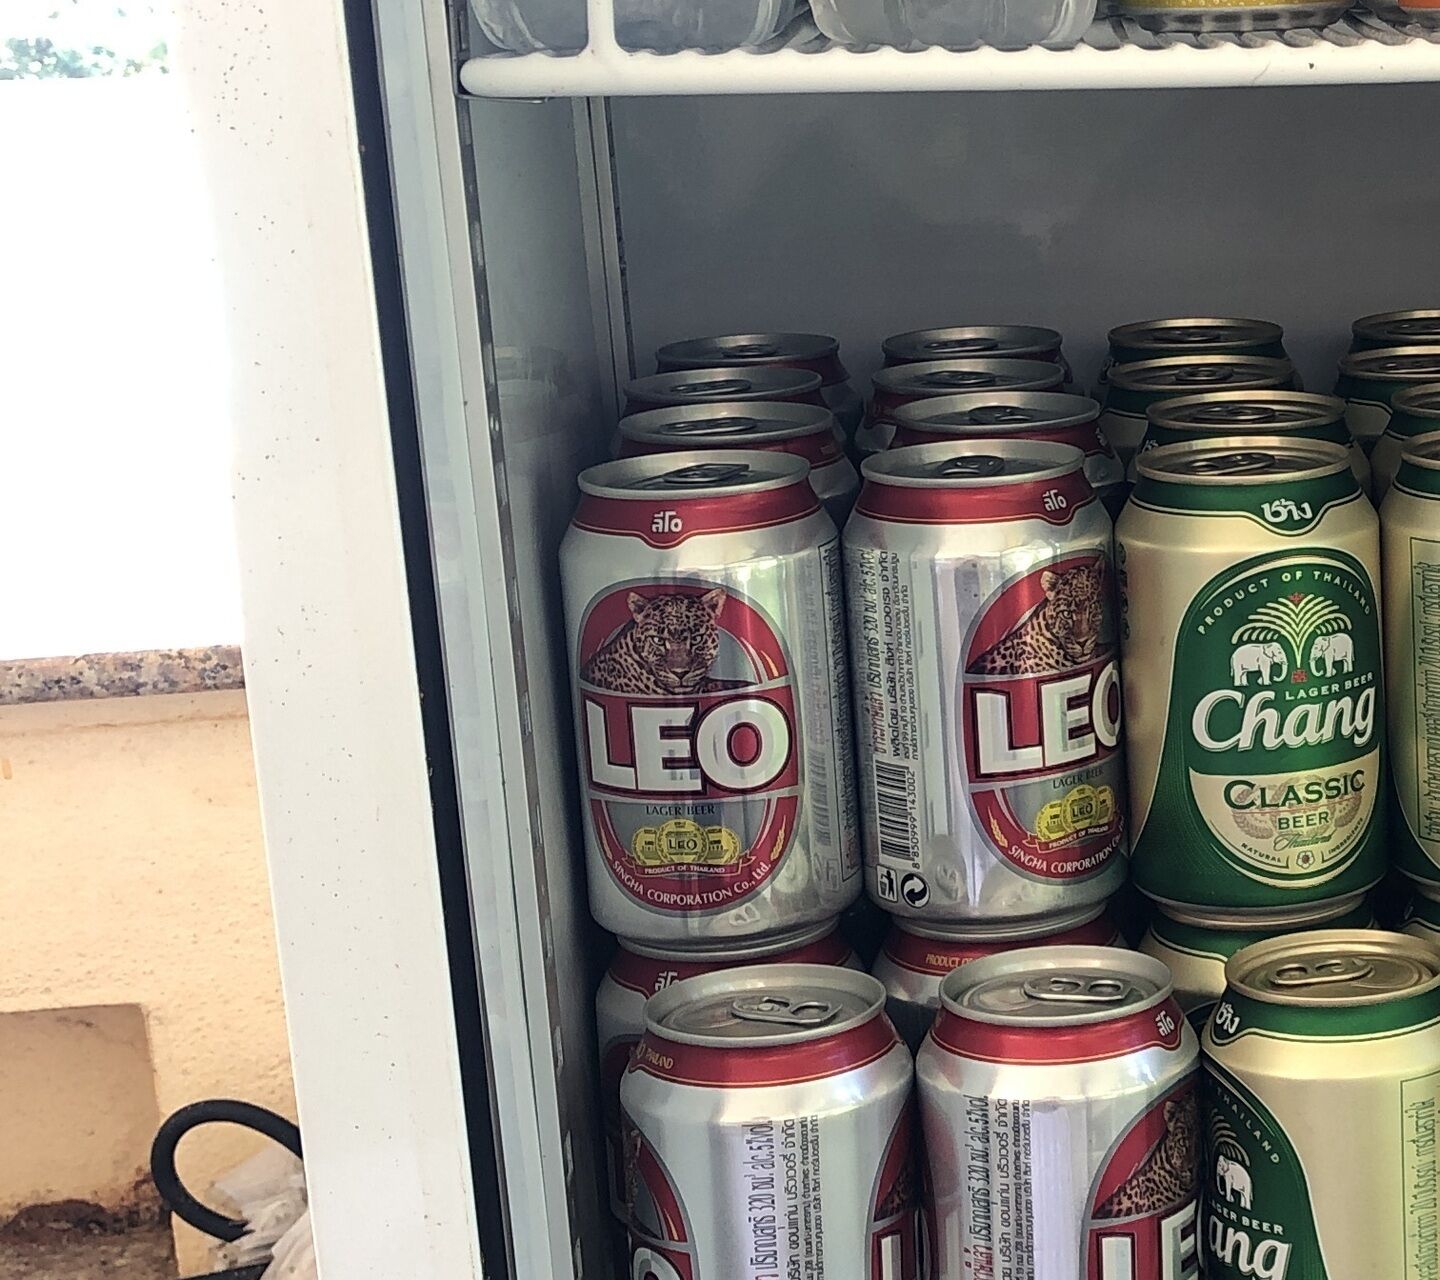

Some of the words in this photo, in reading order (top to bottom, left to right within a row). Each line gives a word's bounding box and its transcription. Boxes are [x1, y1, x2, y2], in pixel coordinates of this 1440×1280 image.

[1043, 489, 1068, 514] ลีโอ
[1261, 498, 1313, 523] ช้าง
[651, 510, 683, 533] ลีโอ
[1198, 578, 1269, 635] PRODUCT
[1281, 570, 1303, 582] OF
[1313, 571, 1371, 615] THAILAND
[1285, 683, 1340, 701] LAGER
[1344, 672, 1374, 689] BEER
[973, 660, 1121, 779] LEO
[1192, 686, 1376, 753] Chang
[586, 696, 791, 793] LEO
[1224, 770, 1365, 810] CLASSIC
[646, 805, 681, 816] LAGER
[687, 805, 715, 815] BEER
[1278, 811, 1330, 831] BEER
[1008, 845, 1047, 872] SINGHA
[1051, 843, 1113, 873] CORPORATION
[1241, 843, 1282, 863] NATURAL
[613, 860, 644, 895] SINGHA
[647, 886, 732, 905] CORPORATION
[752, 862, 772, 881] Ltd.
[1156, 1008, 1175, 1036] ลีโอ
[747, 1194, 775, 1212] 320
[1242, 1215, 1284, 1236] BEER
